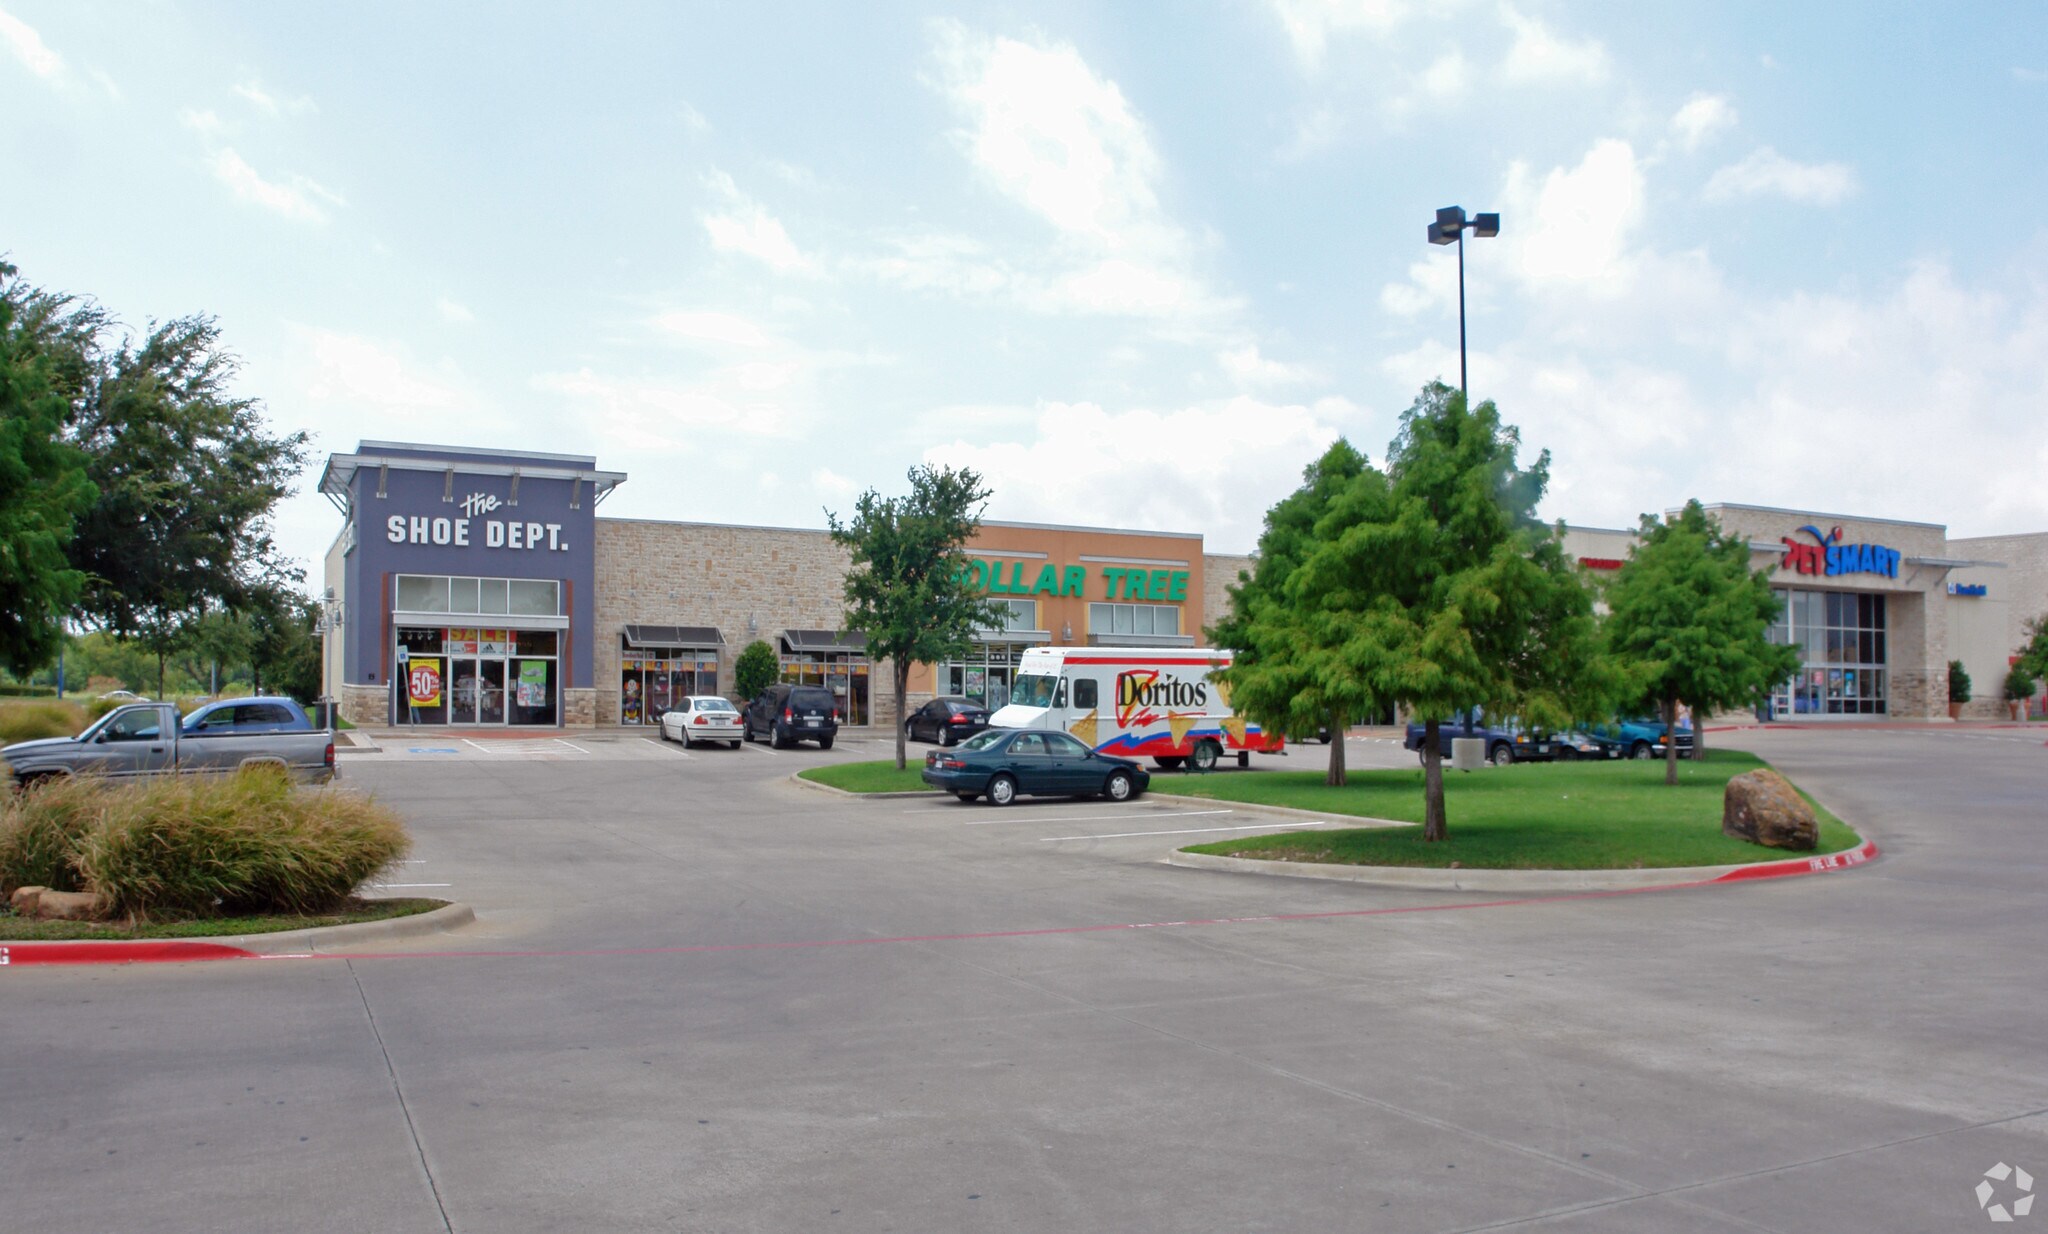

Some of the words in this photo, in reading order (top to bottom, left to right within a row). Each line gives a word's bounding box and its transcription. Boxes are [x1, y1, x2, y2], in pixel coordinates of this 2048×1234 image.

[459, 492, 502, 518] the
[387, 515, 470, 546] SHOE
[486, 520, 569, 551] DEPT.
[951, 559, 1087, 597] OLLAR
[1102, 566, 1190, 601] TREE
[451, 628, 507, 642] SALE
[1118, 673, 1207, 707] Doritos
